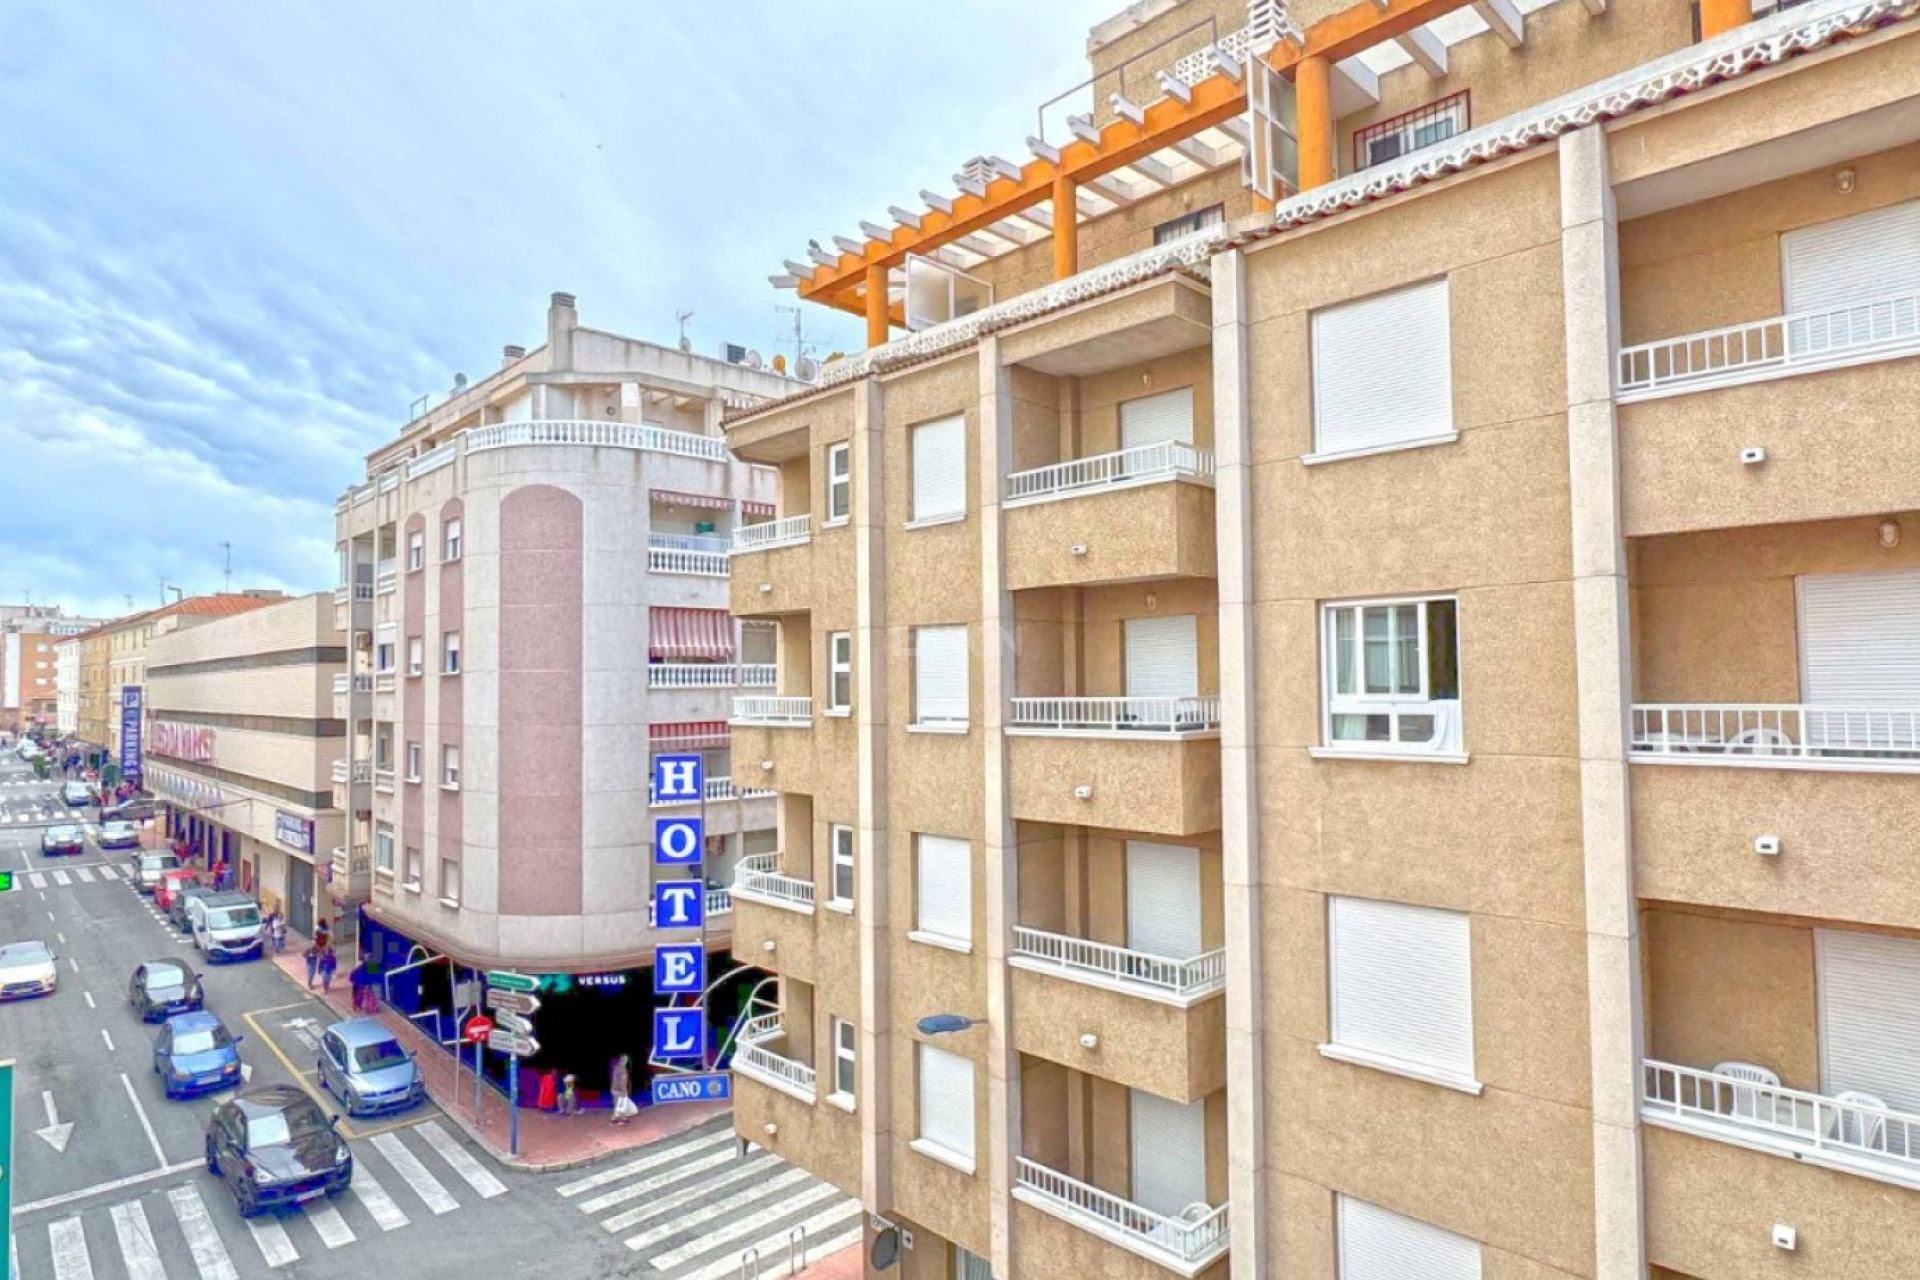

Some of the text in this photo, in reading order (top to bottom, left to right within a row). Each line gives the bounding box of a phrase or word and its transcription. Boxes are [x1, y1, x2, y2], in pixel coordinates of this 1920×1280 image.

[124, 720, 138, 767] PARKING
[660, 761, 697, 1051] HOTEL
[578, 974, 626, 986] VERSUS
[658, 1080, 701, 1099] CANO
